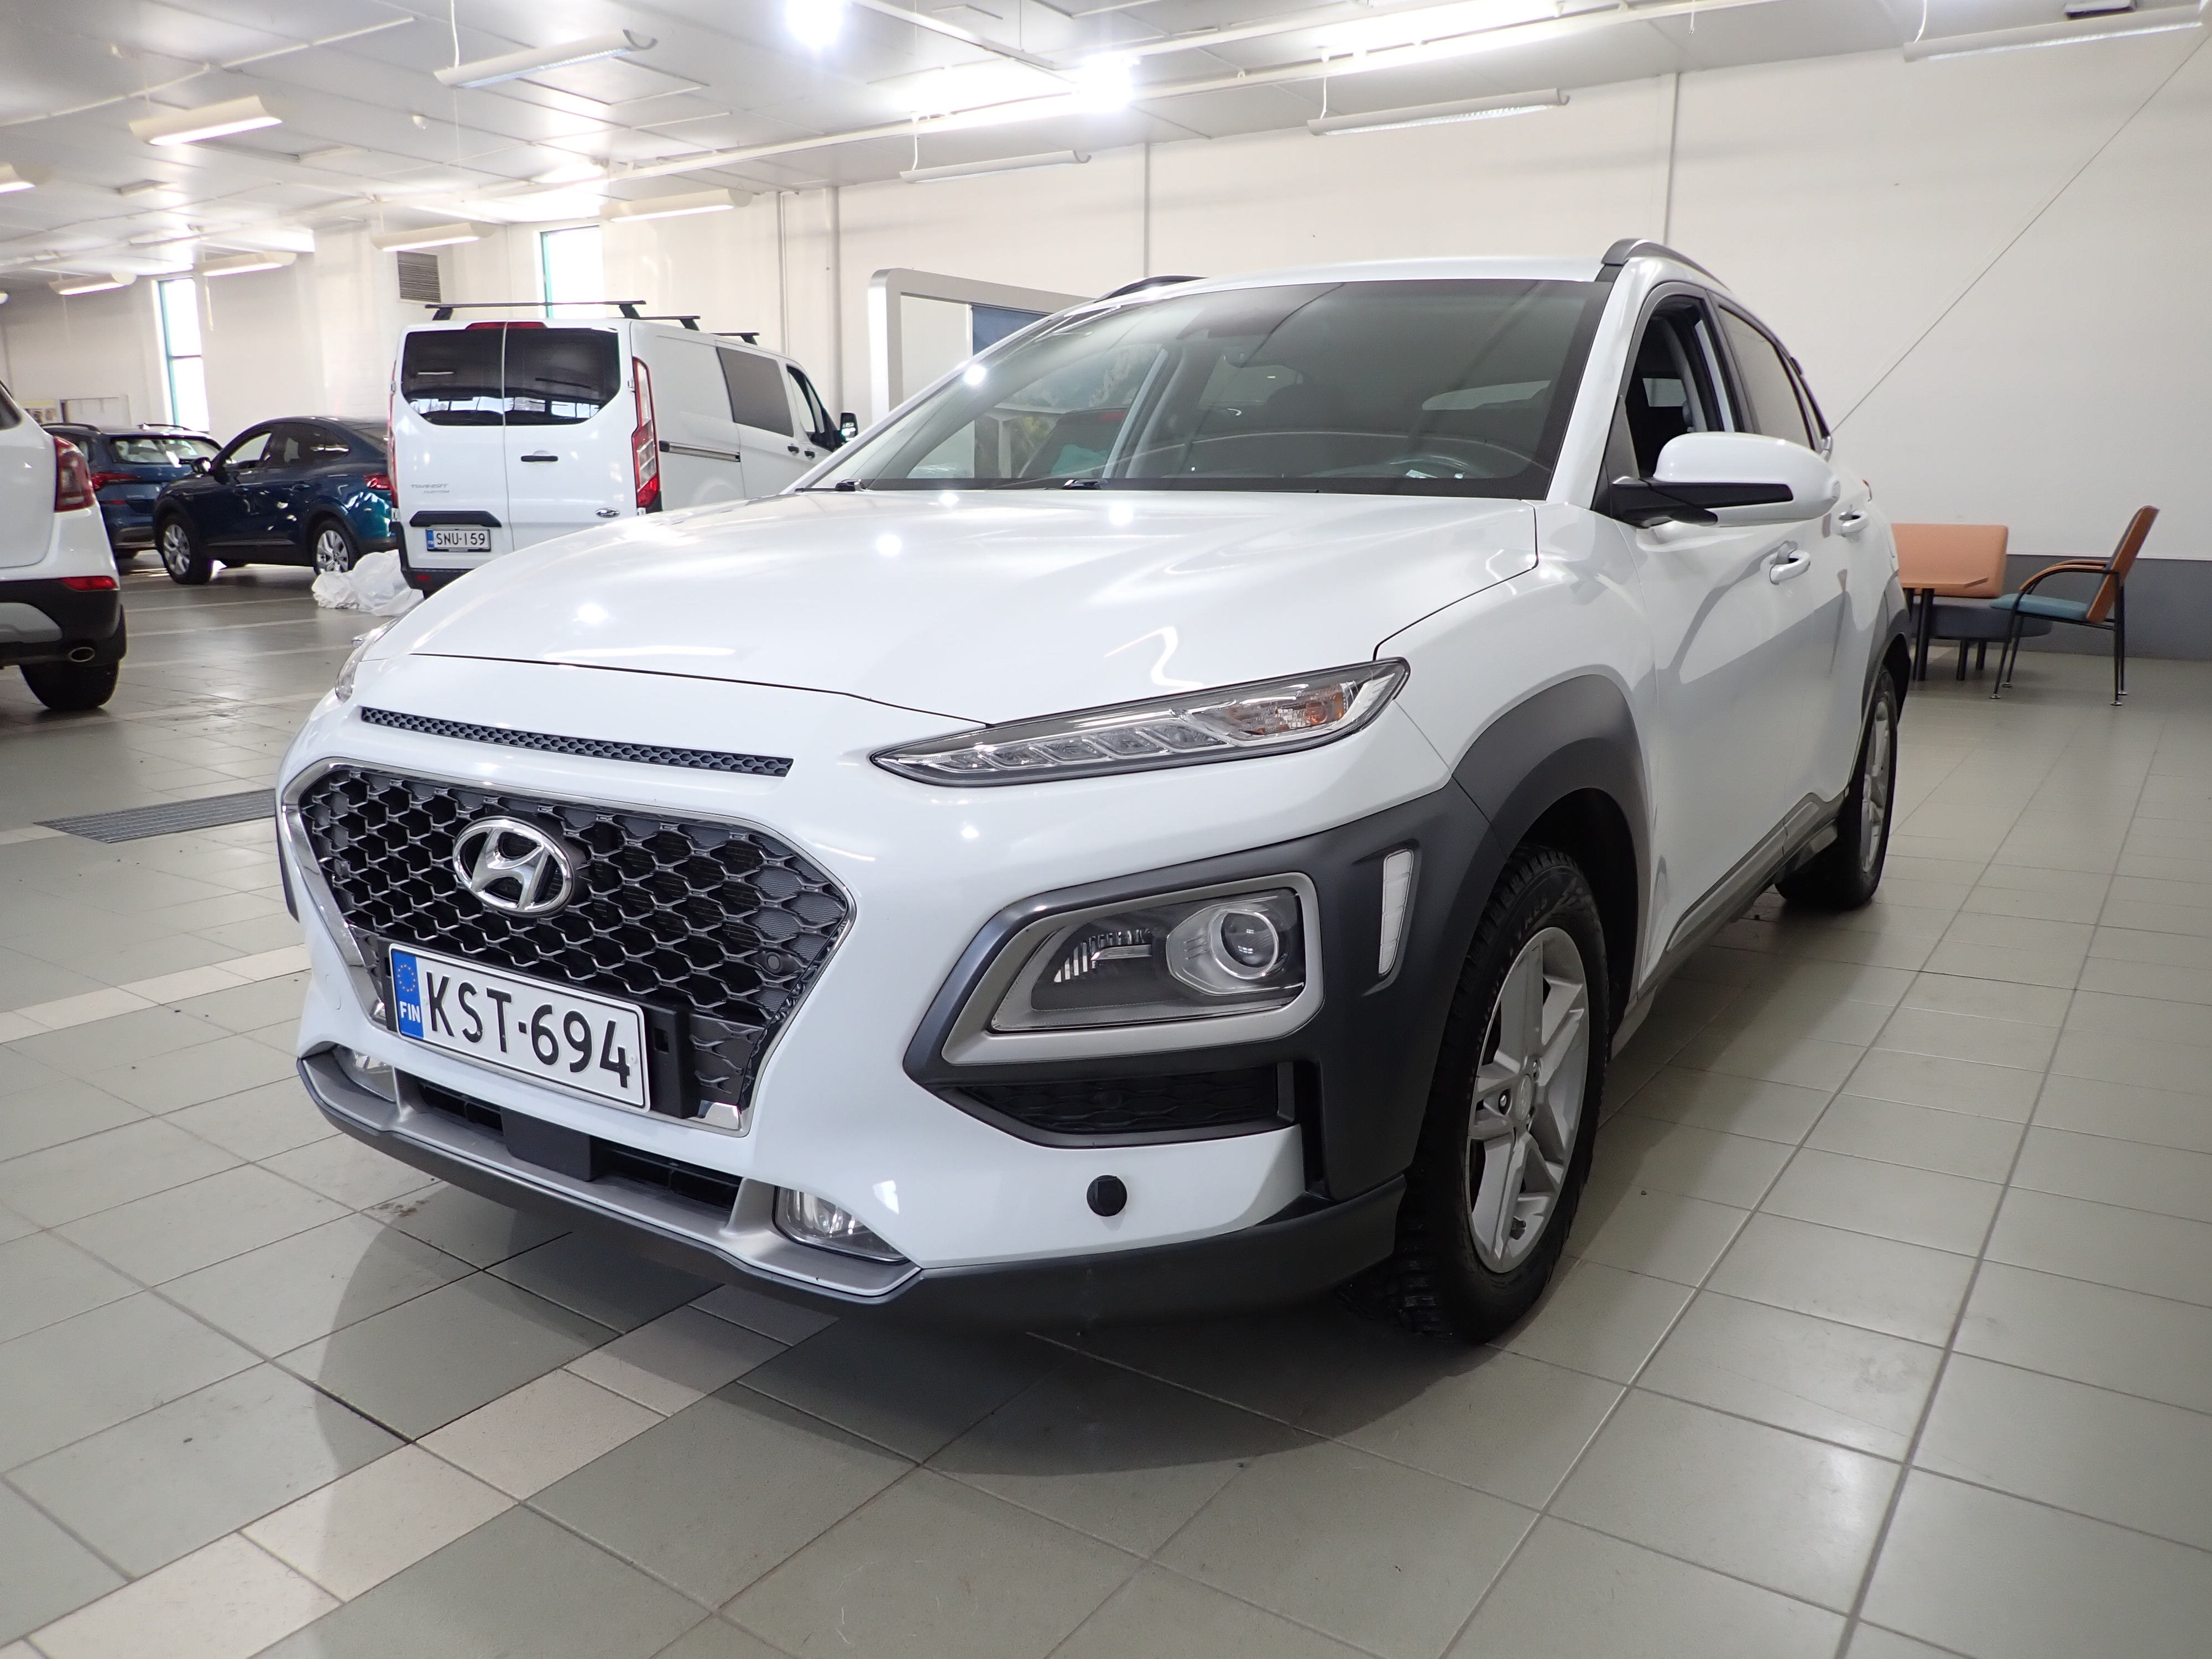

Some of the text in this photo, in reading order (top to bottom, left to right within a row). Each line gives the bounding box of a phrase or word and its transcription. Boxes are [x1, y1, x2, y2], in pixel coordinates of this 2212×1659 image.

[436, 533, 485, 545] SNU-159
[399, 971, 631, 1089] FIN KST-694
